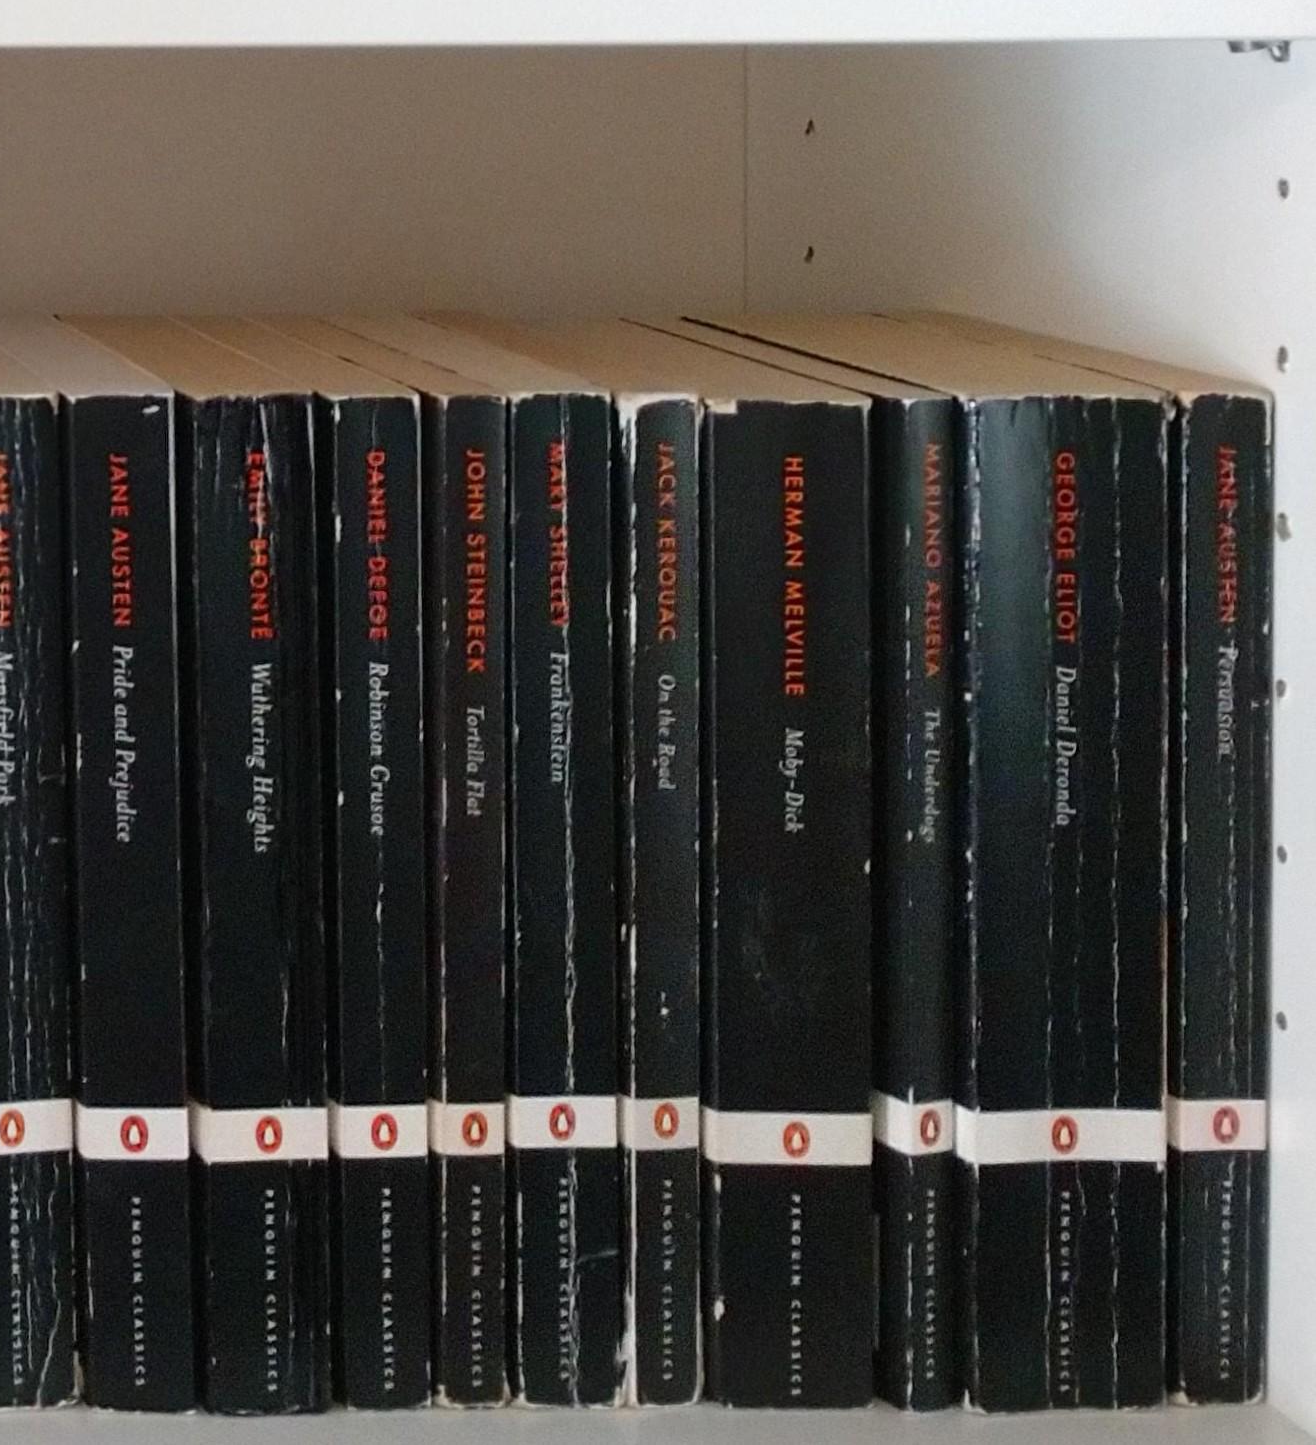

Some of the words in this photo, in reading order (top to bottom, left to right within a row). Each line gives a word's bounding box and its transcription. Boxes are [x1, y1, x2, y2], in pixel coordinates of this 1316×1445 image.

[109, 453, 130, 517] JANE
[784, 456, 804, 567] HERMAN
[1055, 450, 1076, 561] GEORGE
[111, 526, 132, 629] AUSTEN
[1056, 572, 1077, 644] ELIOT
[112, 643, 133, 697] Pride
[785, 579, 805, 697] MELVILLE
[114, 701, 134, 745] and
[1056, 665, 1077, 737] Daniel
[108, 750, 133, 844] Prejudice
[778, 728, 805, 834] Moby-Dick
[1056, 741, 1077, 826] Deronda
